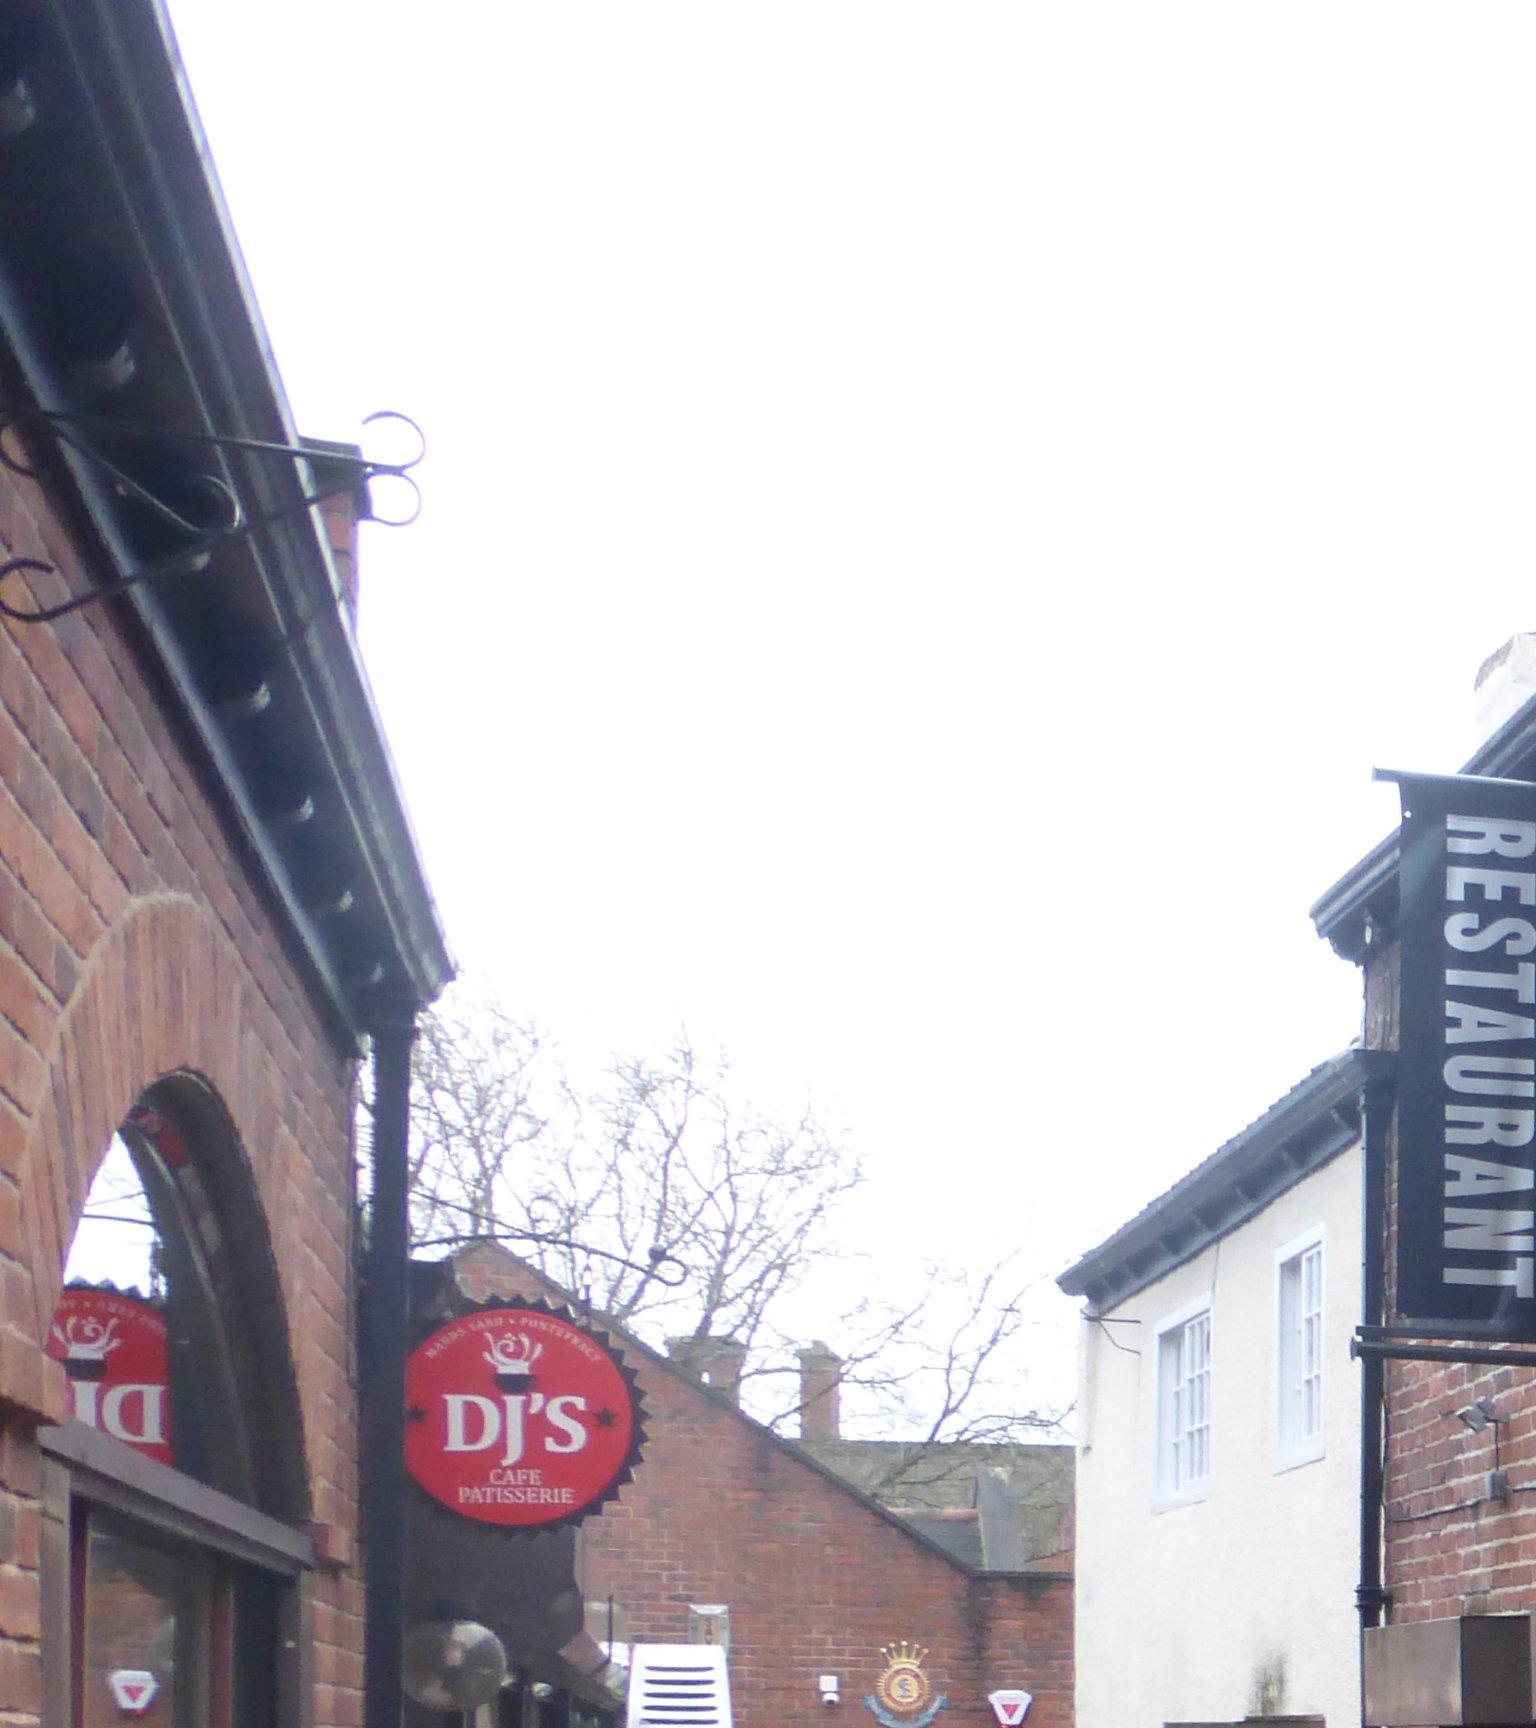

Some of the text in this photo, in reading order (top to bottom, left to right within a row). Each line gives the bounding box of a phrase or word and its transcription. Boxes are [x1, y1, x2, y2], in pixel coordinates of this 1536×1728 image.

[521, 1316, 600, 1362] PONTEFRACT
[442, 1392, 588, 1467] DJ'S
[488, 1468, 542, 1486] CAFE
[458, 1486, 575, 1504] PATISSERIE
